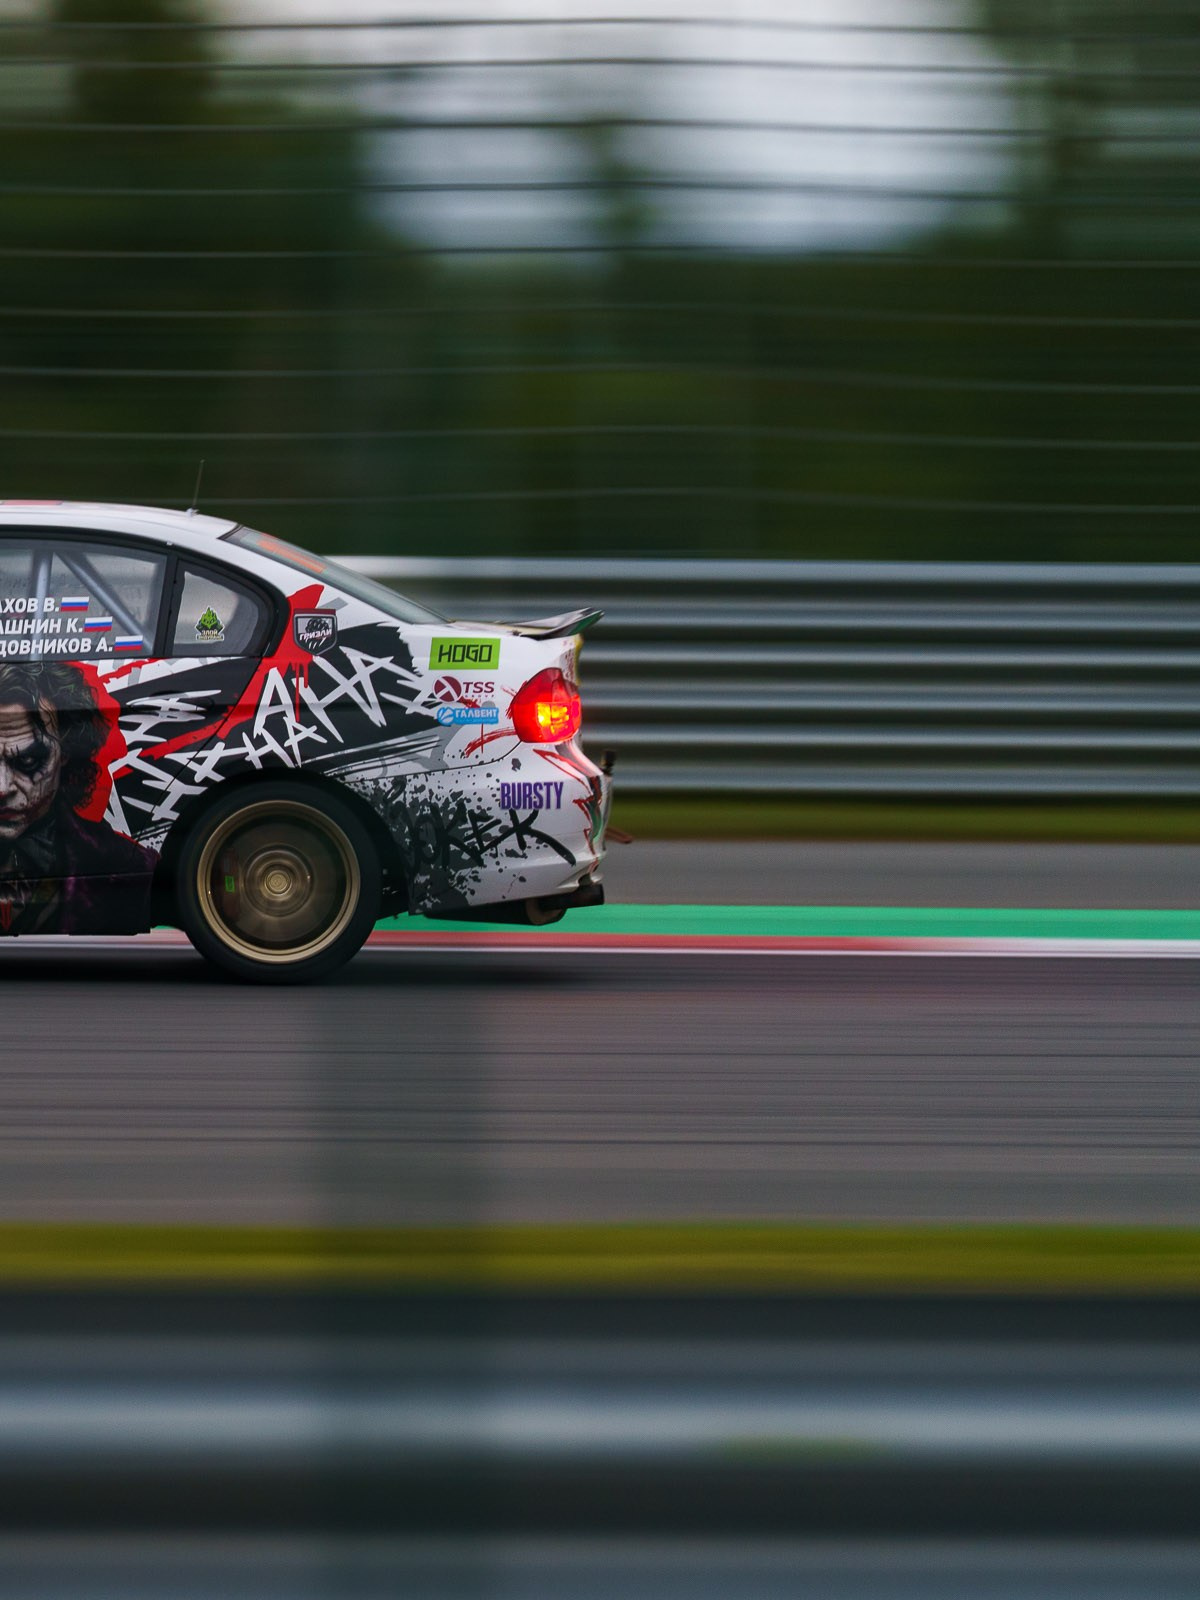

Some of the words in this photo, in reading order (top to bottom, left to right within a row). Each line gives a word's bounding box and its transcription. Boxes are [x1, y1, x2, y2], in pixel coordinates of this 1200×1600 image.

[43, 597, 60, 613] В.
[66, 617, 84, 634] К.
[95, 637, 113, 652] А.
[438, 644, 493, 663] HOGO
[463, 681, 495, 694] TSS
[455, 708, 497, 718] ГАЛВЕНТ
[501, 781, 564, 811] BURSTY
